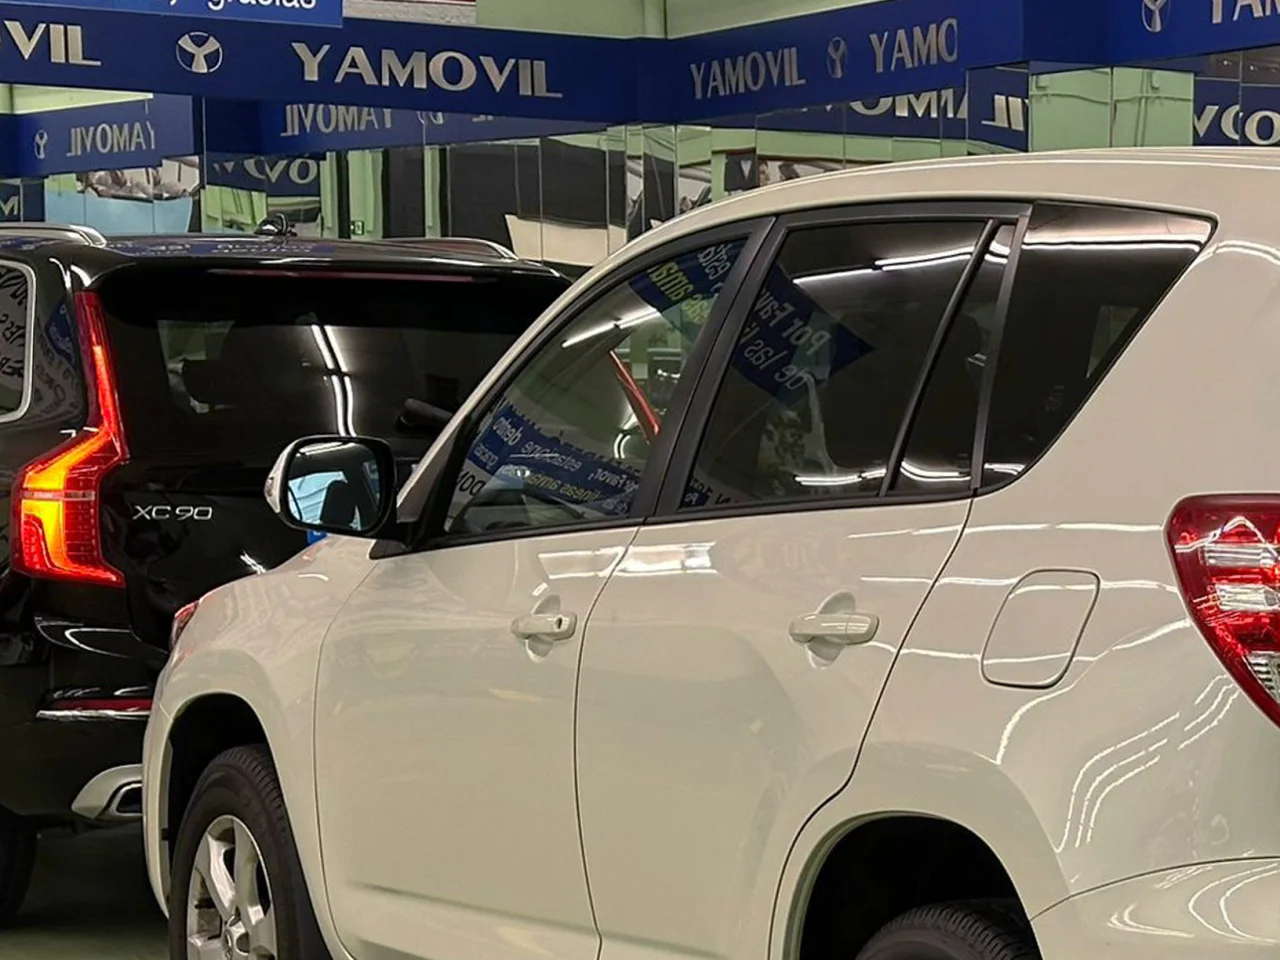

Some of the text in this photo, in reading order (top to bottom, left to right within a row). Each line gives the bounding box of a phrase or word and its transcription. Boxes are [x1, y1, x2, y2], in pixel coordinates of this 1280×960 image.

[0, 19, 102, 66] VIL
[290, 41, 563, 99] YAMOVIL
[690, 46, 806, 99] YAMOVIL
